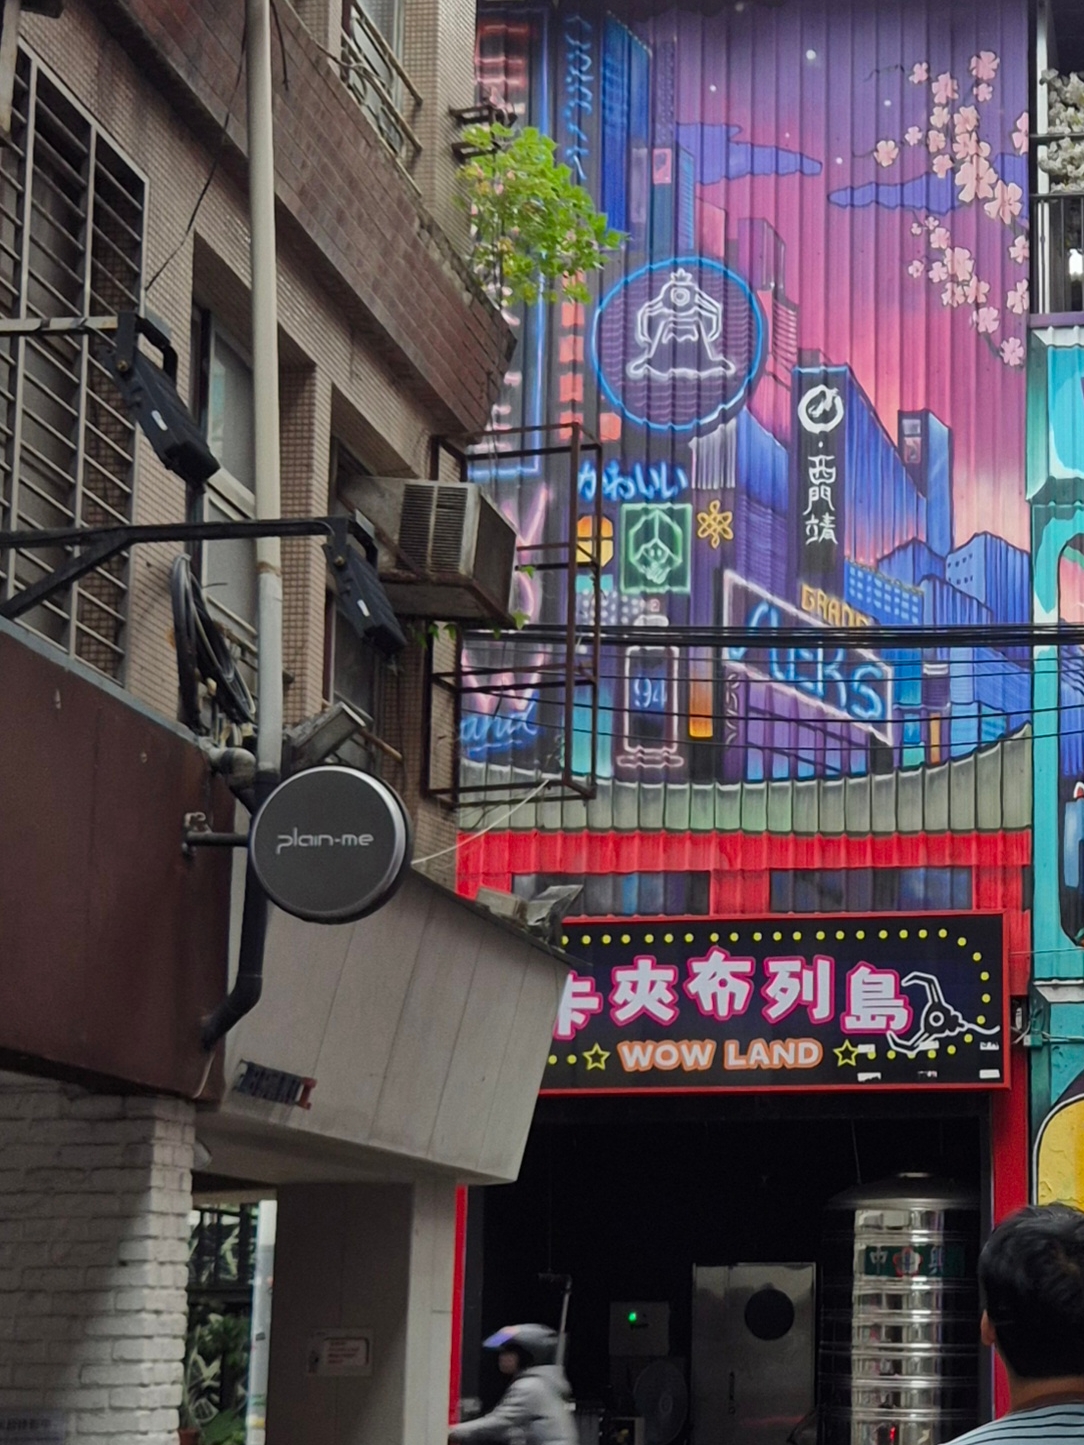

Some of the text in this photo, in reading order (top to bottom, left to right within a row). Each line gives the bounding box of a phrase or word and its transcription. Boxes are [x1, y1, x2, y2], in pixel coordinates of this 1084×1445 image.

[577, 460, 689, 500] かわいい
[276, 827, 374, 854] plain-me
[619, 1040, 822, 1071] WOW LAND
